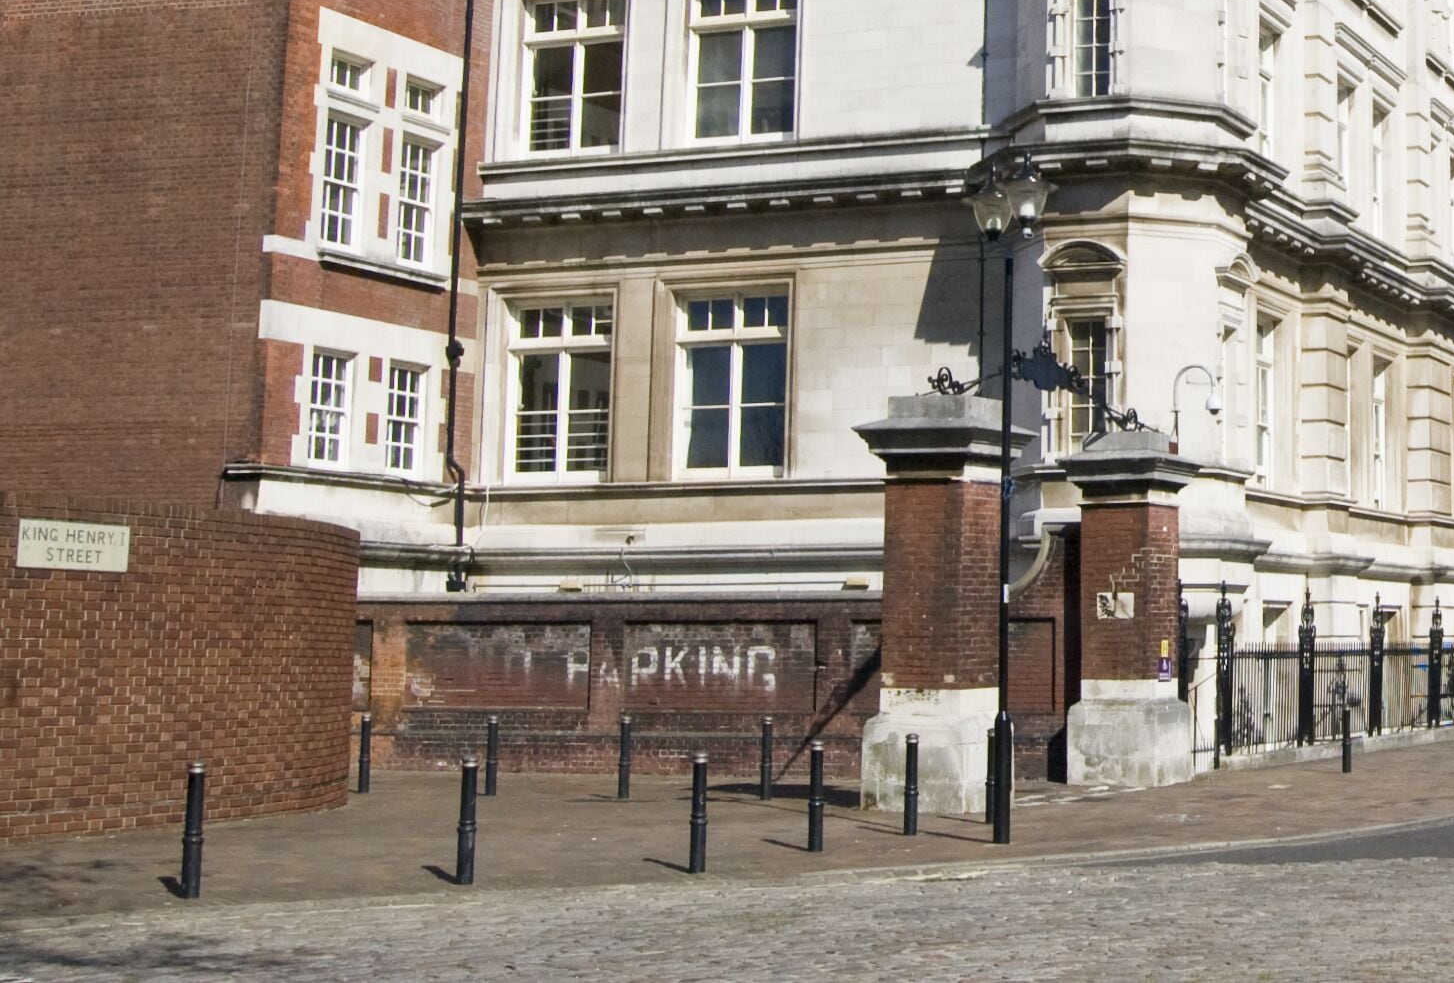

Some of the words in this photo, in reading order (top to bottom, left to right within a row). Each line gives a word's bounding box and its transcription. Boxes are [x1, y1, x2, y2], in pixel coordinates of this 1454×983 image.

[21, 526, 58, 541] KING
[66, 529, 115, 545] HENRY
[46, 547, 103, 564] STREET
